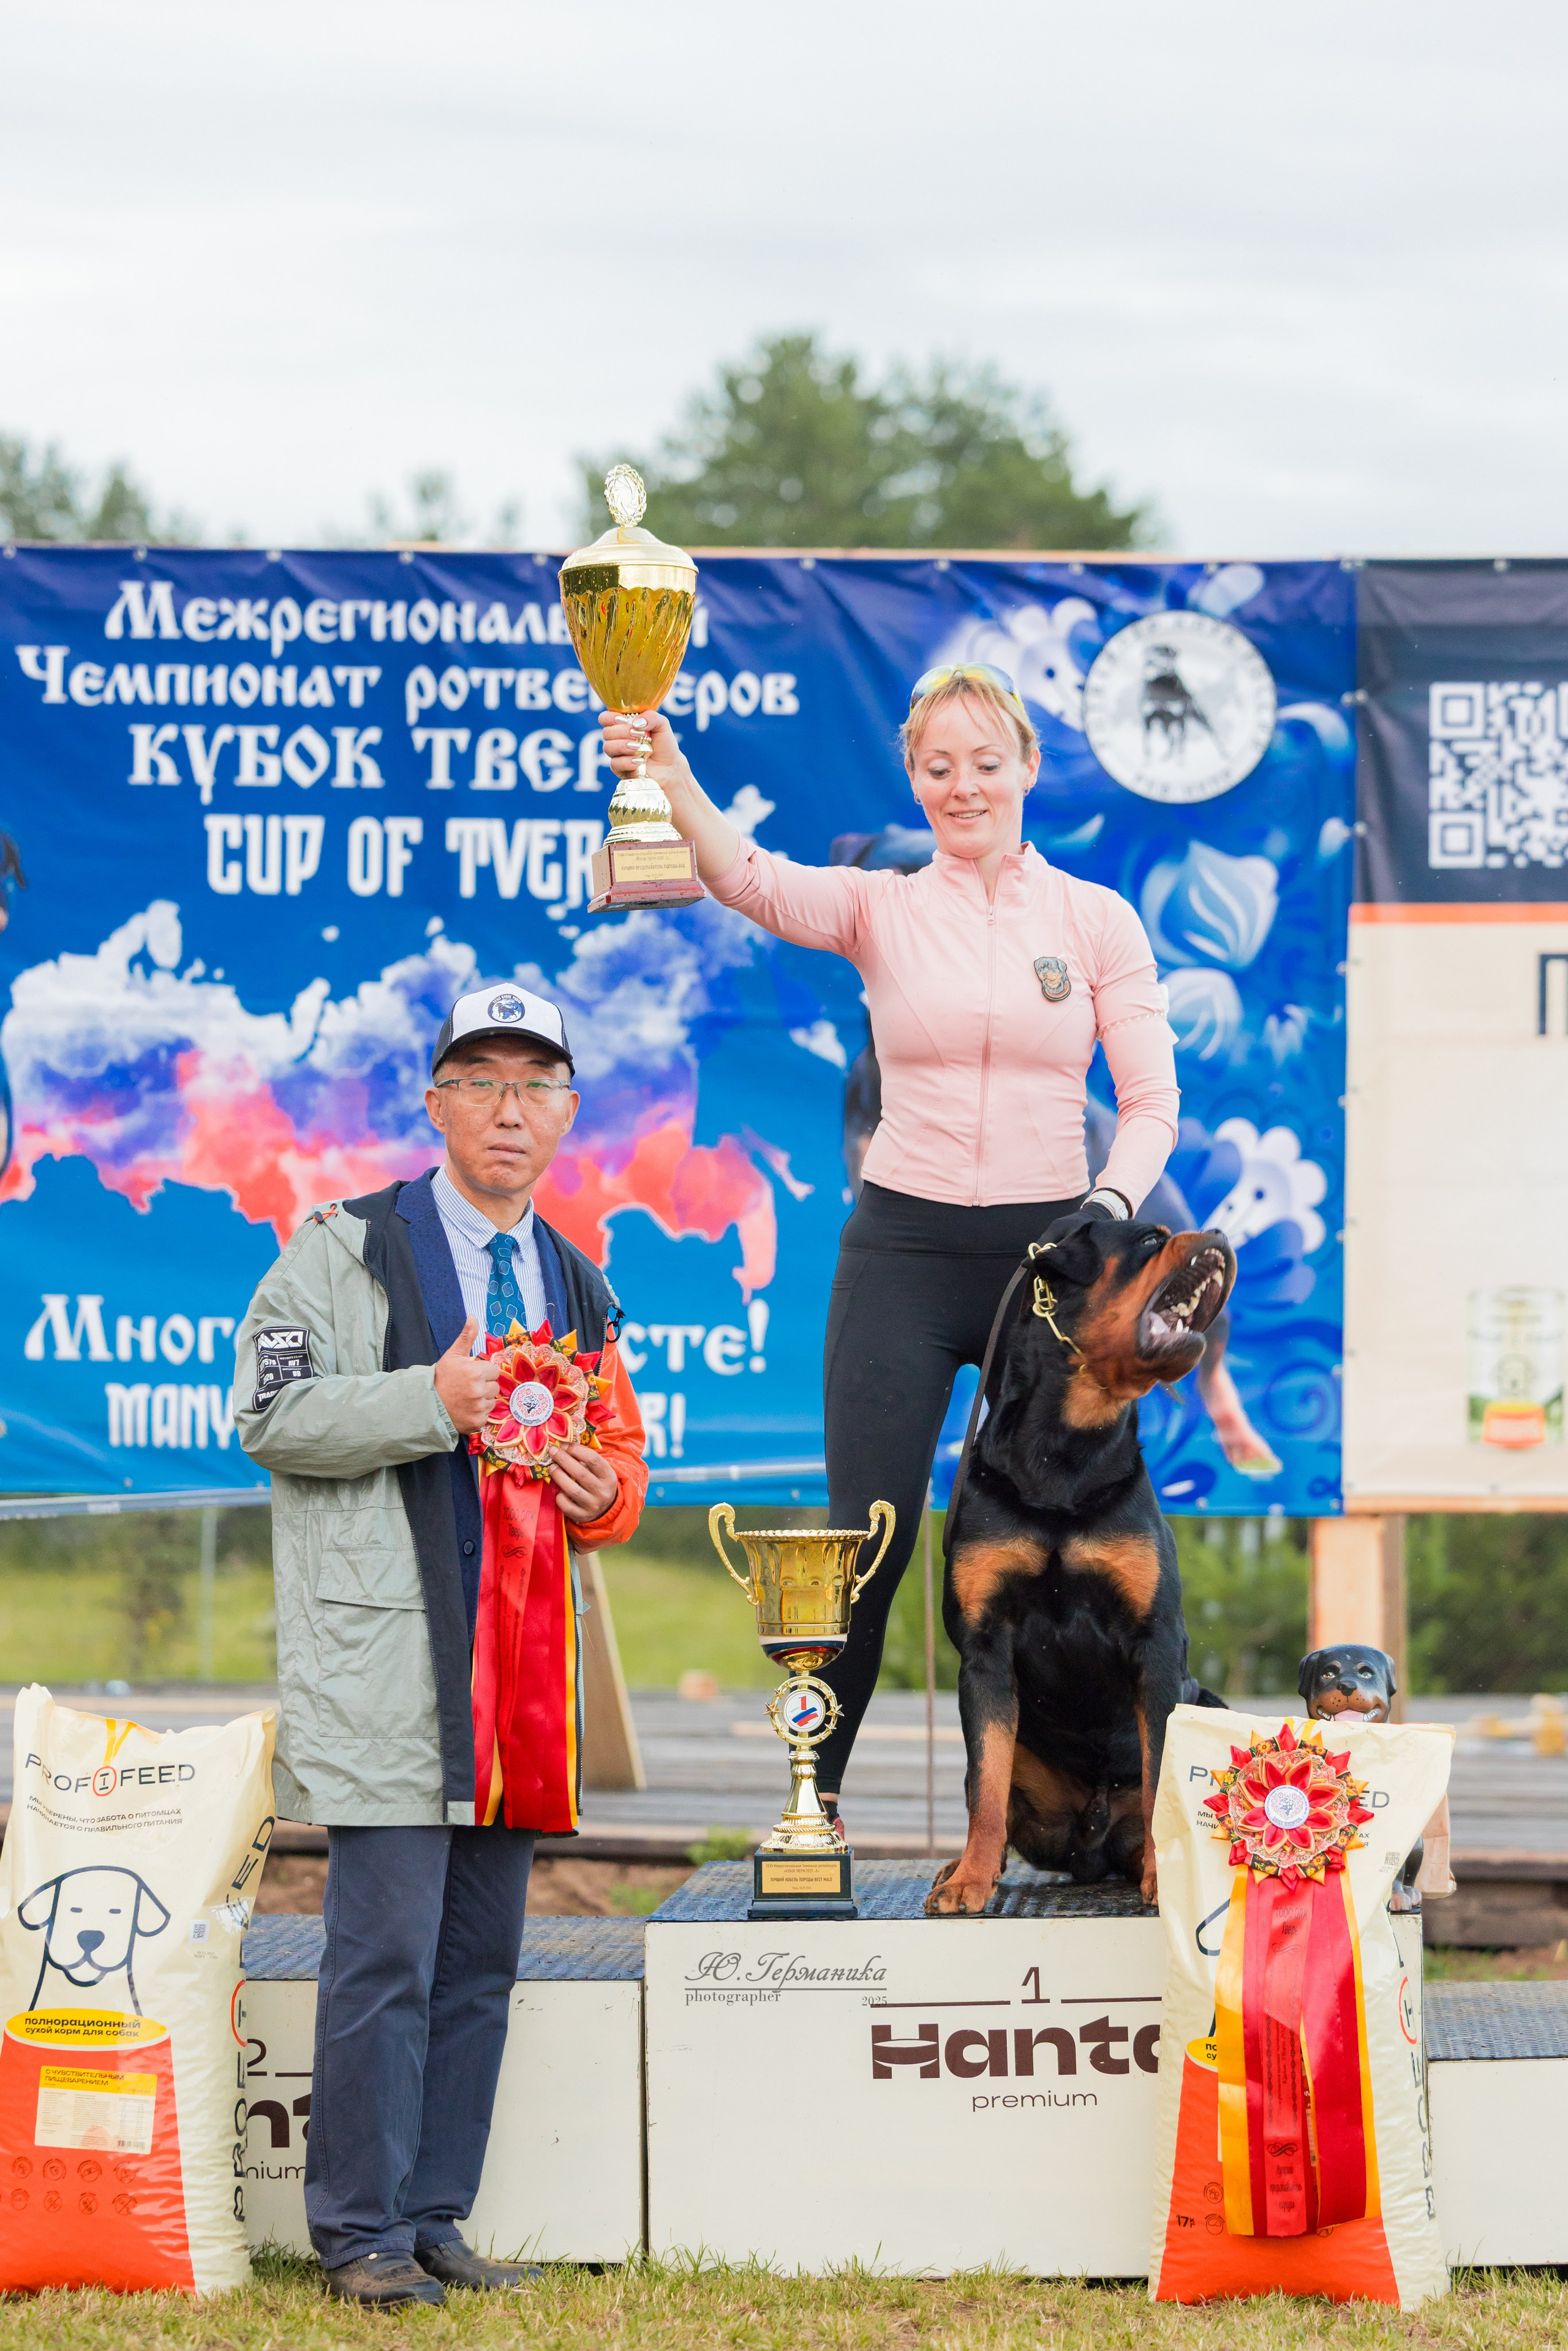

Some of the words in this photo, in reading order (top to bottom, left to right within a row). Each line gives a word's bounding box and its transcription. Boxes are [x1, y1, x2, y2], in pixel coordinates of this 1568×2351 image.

[15, 645, 382, 708] Чемпионат
[405, 665, 800, 731] ротвееров
[128, 723, 385, 806] КУБОК
[412, 728, 682, 792] ТВЕР
[204, 813, 326, 896] CUP
[347, 815, 424, 897] OF
[24, 1294, 242, 1365] Мног
[96, 1814, 127, 1823] ЗАБОТА
[135, 1808, 182, 1819] ПИТОМЦАХ
[84, 1822, 143, 1833] ПРАВИЛЬНОГО
[144, 1817, 183, 1827] ПИТАНИЯ
[1021, 1967, 1050, 2004] 1
[25, 2018, 140, 2029] полнорационный
[26, 2026, 52, 2034] сухой
[45, 2075, 109, 2086] ПИЩЕВАРЕНИЕМ
[52, 2070, 124, 2080] ЧУВСТВИТЕЛЬНЫМ
[972, 2090, 1098, 2112] premium
[1176, 2215, 1189, 2227] 17
